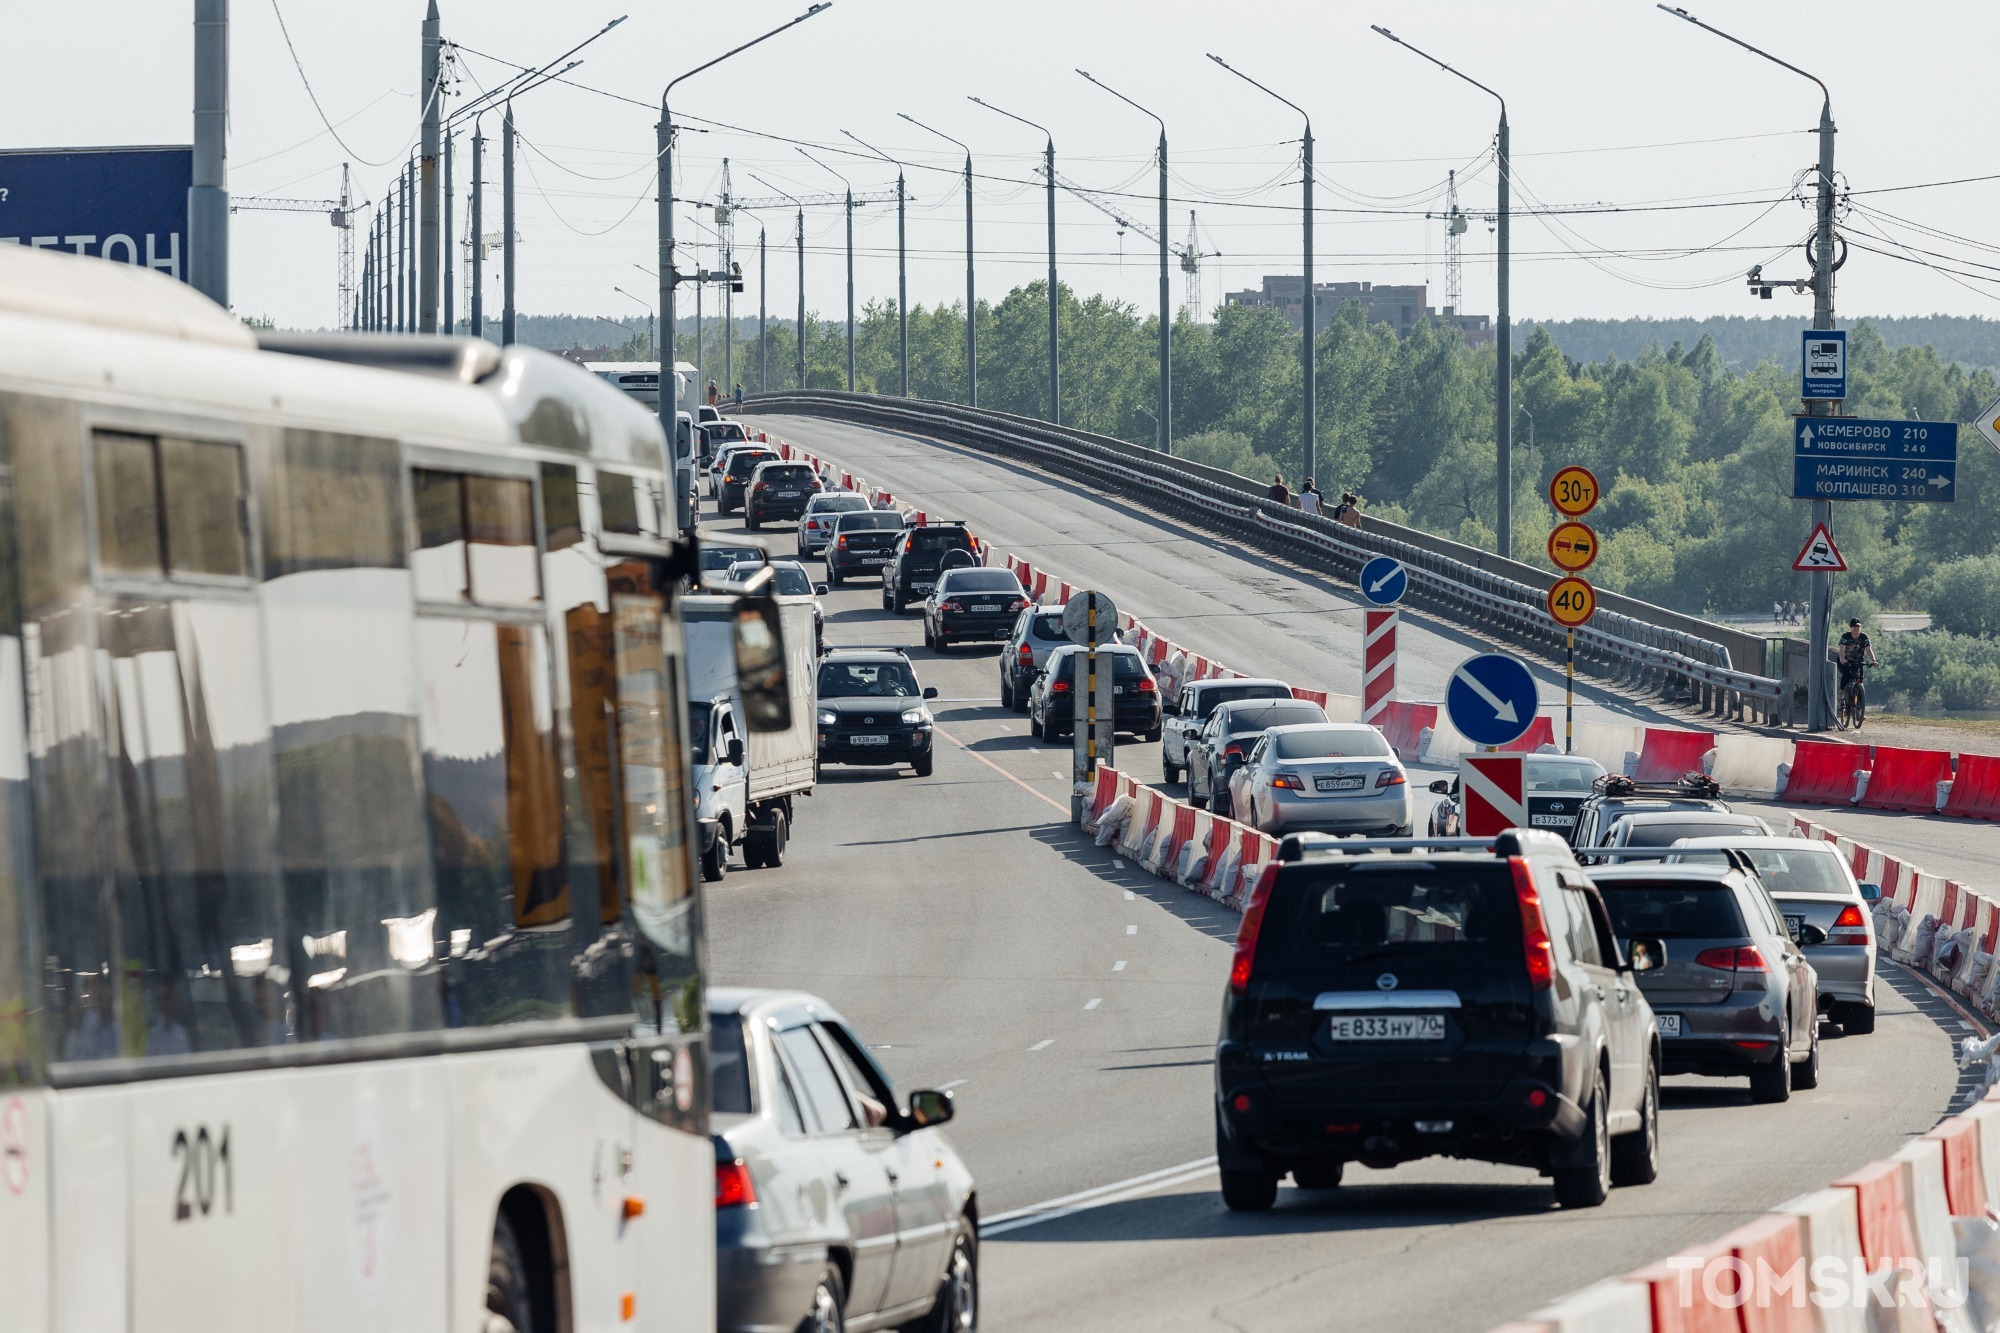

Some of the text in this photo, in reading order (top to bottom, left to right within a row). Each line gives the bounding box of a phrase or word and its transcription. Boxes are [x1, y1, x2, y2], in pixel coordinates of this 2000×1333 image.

[1818, 424, 1928, 440] КЕМЕРОВО 210
[1817, 441, 1926, 453] НОВОСИБИРСК 240
[1817, 464, 1926, 480] МАРИИНСК 240
[1816, 481, 1926, 497] КОЛПАШЕВО 310
[1555, 590, 1586, 611] 40
[171, 1121, 234, 1221] 201
